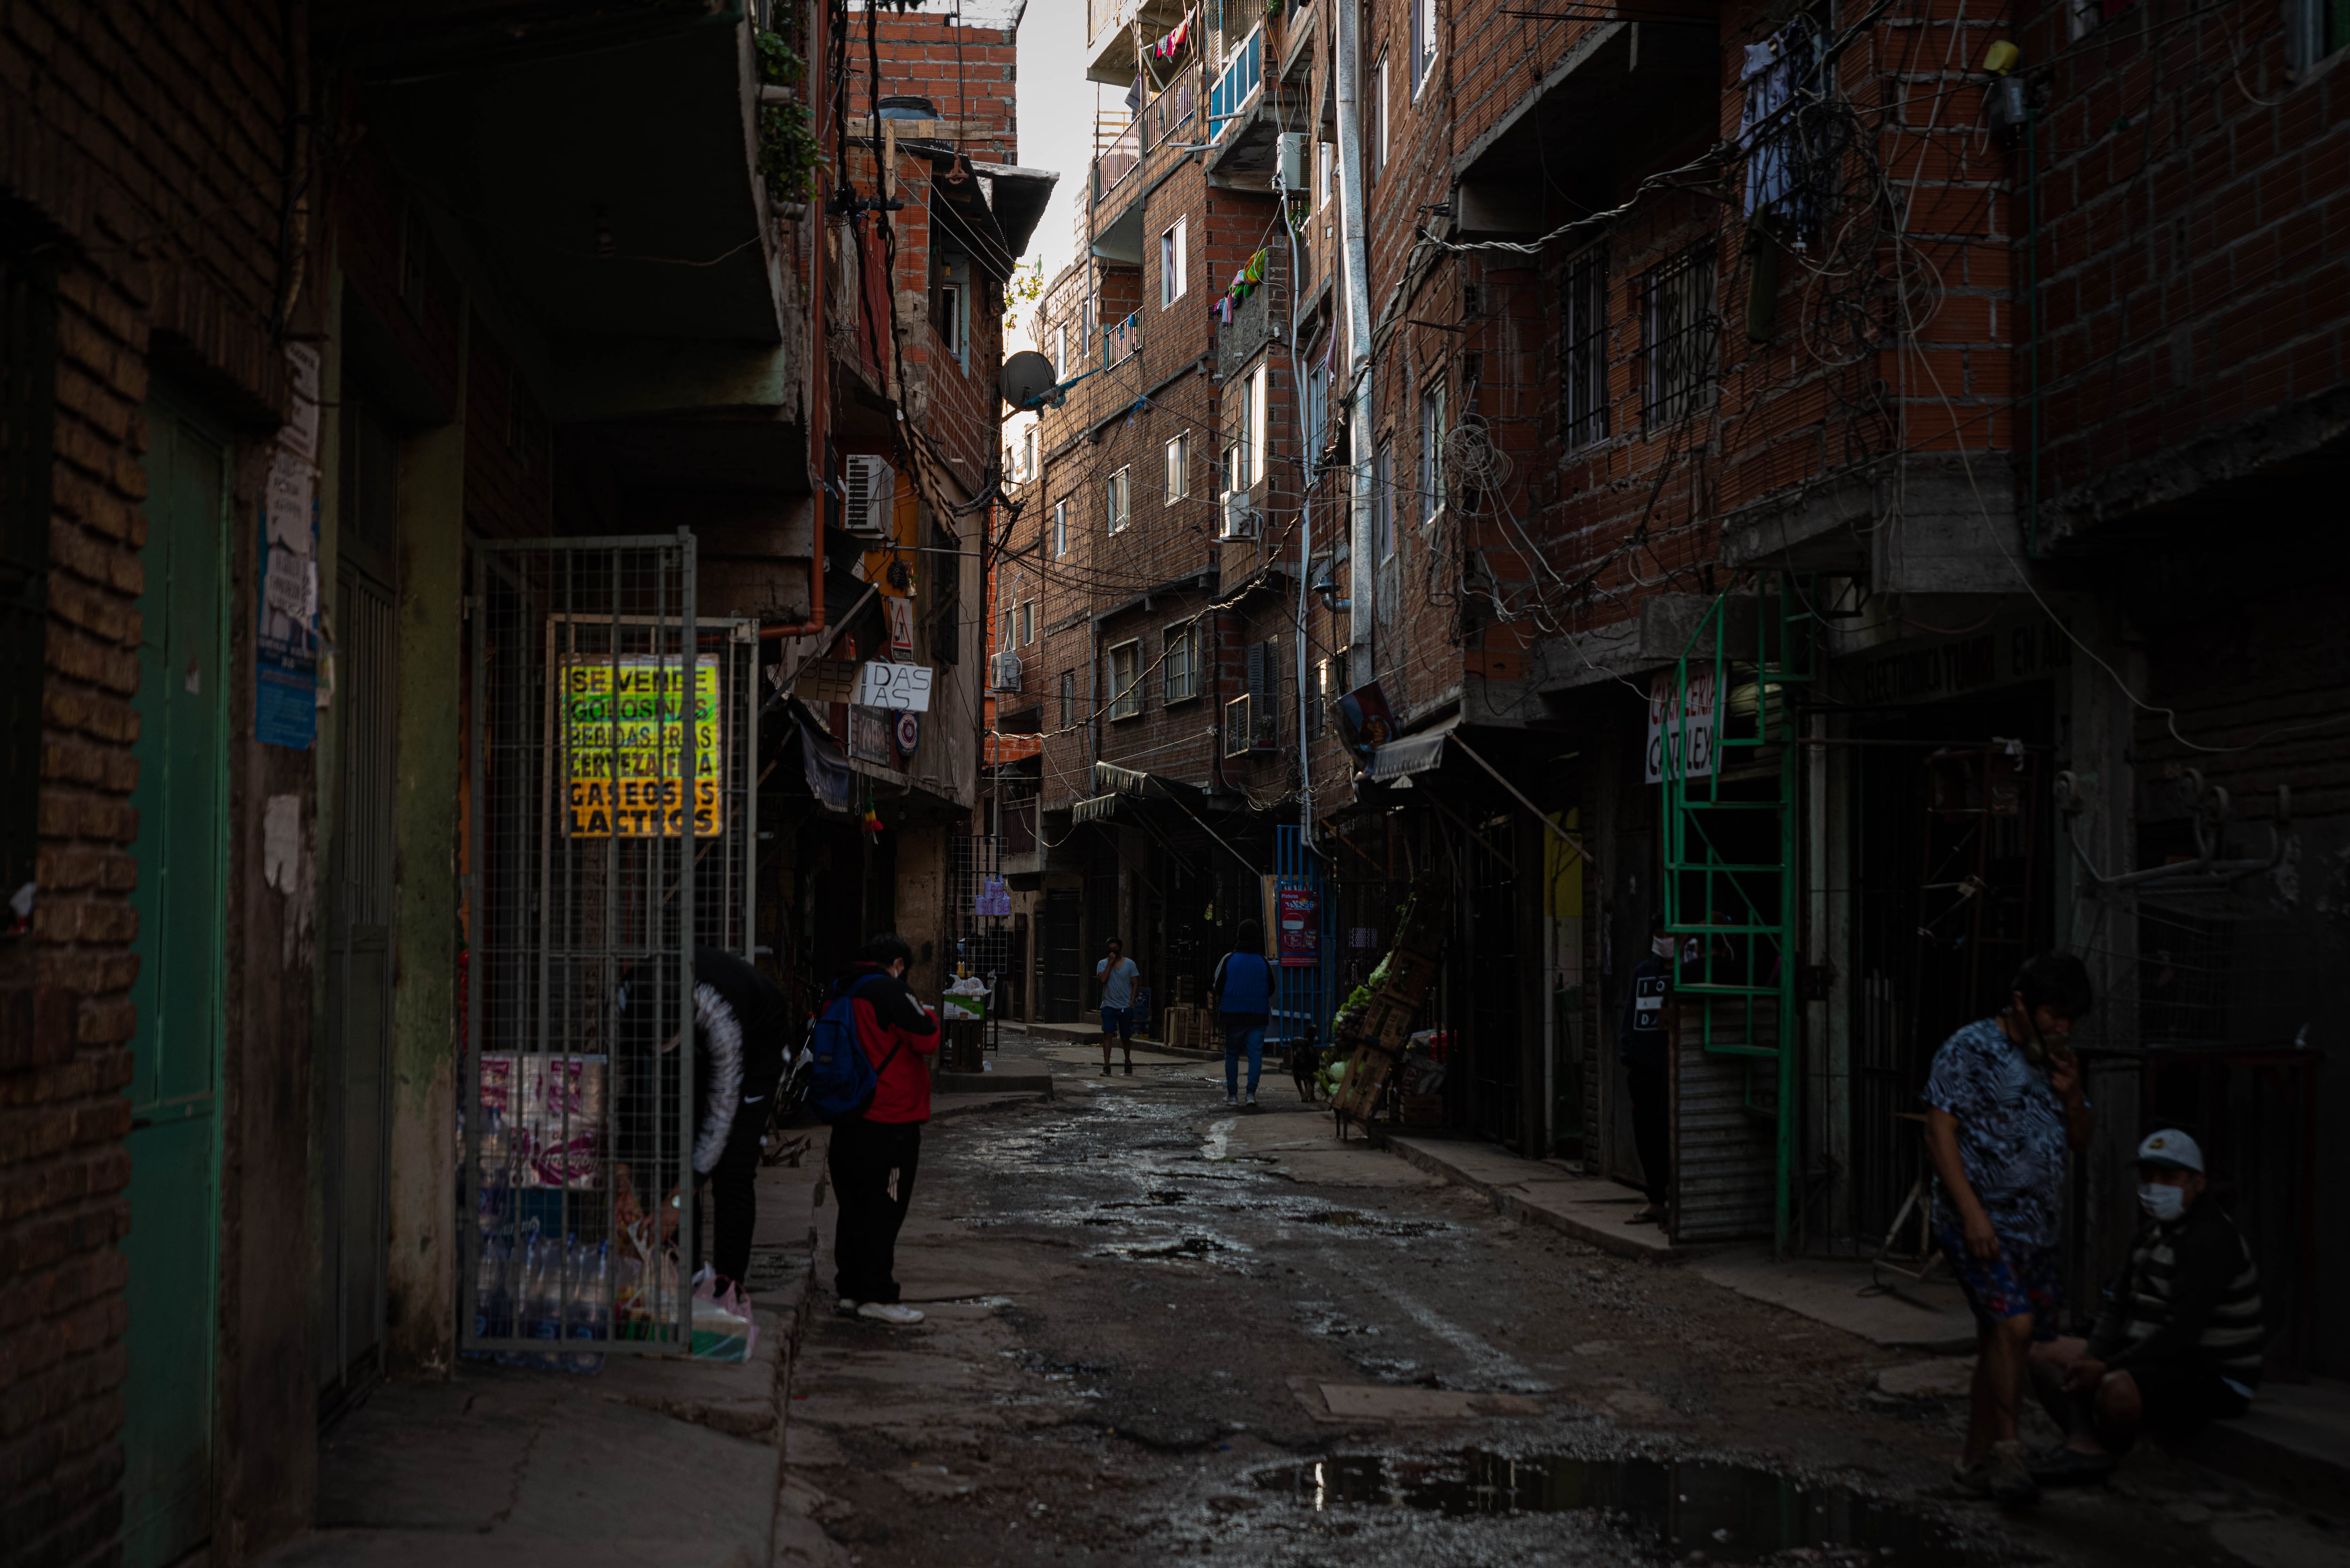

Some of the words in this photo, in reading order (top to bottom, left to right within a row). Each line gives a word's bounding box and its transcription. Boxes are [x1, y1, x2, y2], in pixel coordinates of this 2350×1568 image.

[2012, 624, 2036, 677] EN
[572, 671, 605, 693] SE
[800, 659, 931, 690] BEBIDAS
[816, 681, 911, 710] FRIAS
